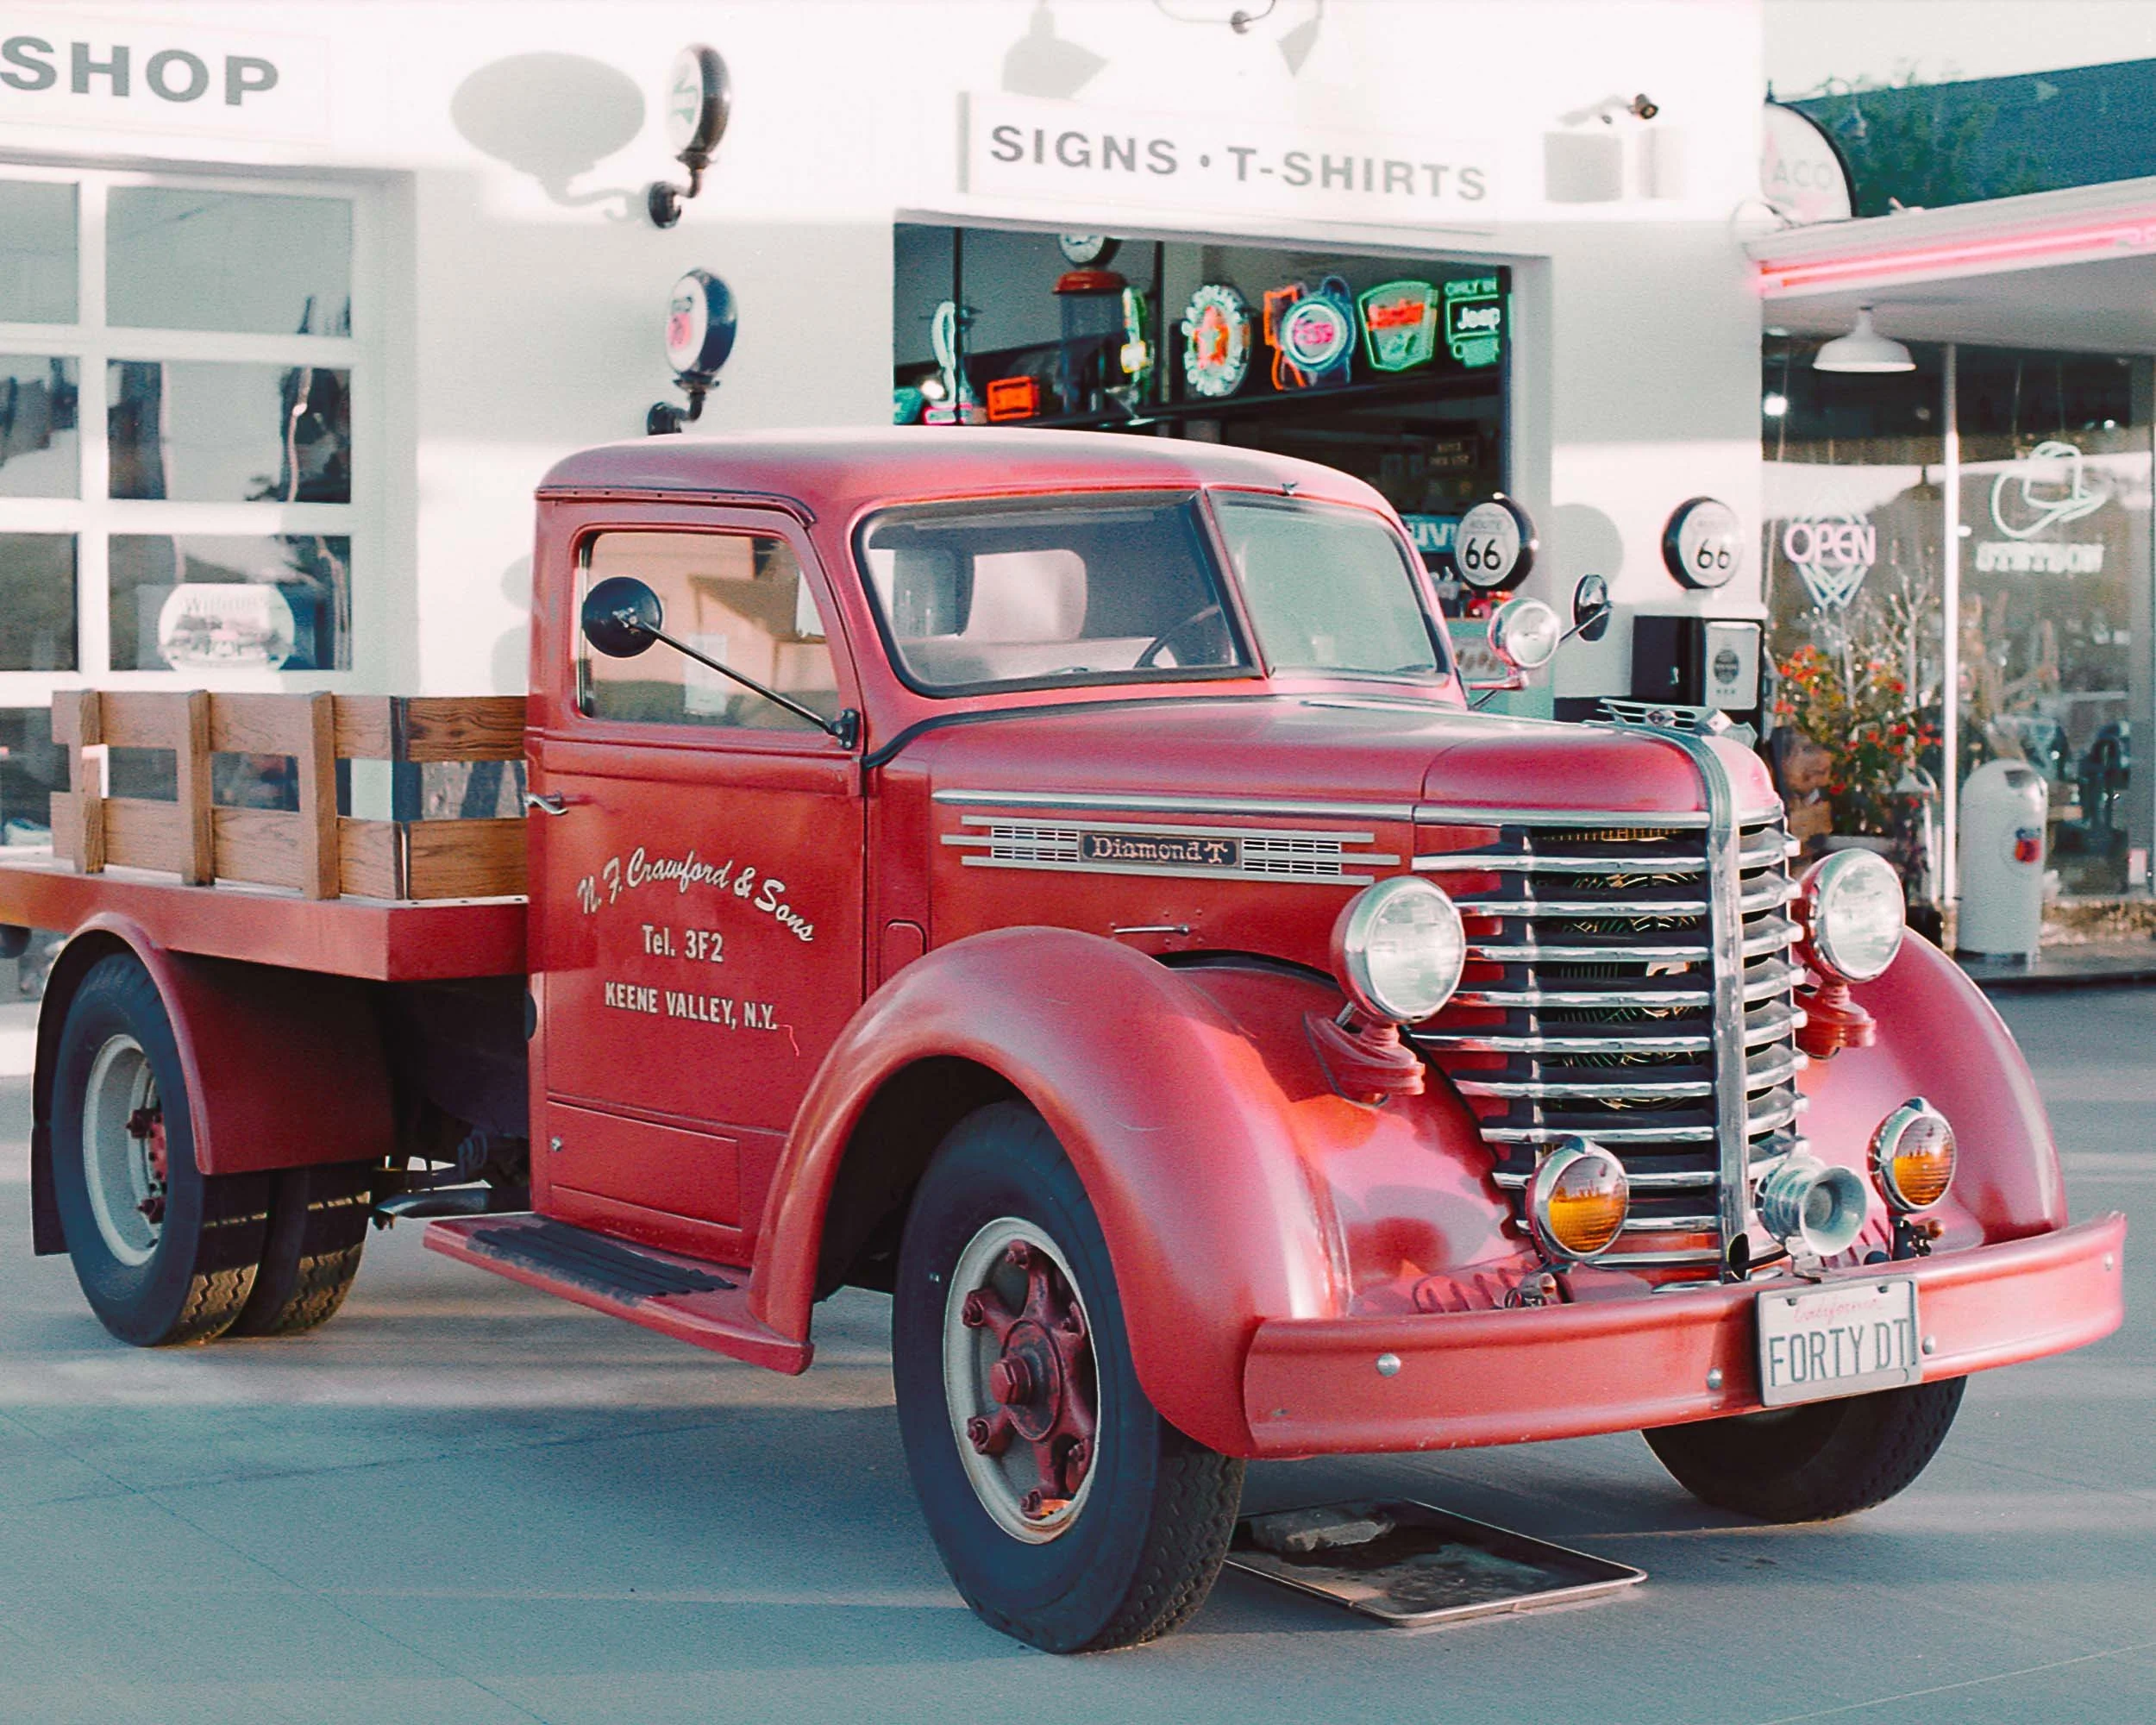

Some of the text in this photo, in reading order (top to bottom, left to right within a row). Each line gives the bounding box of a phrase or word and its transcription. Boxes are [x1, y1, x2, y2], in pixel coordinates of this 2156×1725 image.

[0, 35, 279, 106] SHOP
[990, 125, 1488, 201] SIGNS T-SHIRTS
[1457, 307, 1501, 330] Jeep
[1465, 537, 1501, 572] 66
[1696, 538, 1731, 569] 66
[1784, 523, 1876, 566] OPEN
[1092, 835, 1229, 863] Diamond T
[577, 875, 602, 914] N.
[626, 846, 734, 894] Crawford
[733, 866, 755, 899] &
[754, 878, 815, 943] Sons
[641, 923, 724, 963] Tel. 3F2
[605, 980, 778, 1031] KEENE VALLEY, N.Y.
[1768, 1318, 1908, 1387] FORTY DT
